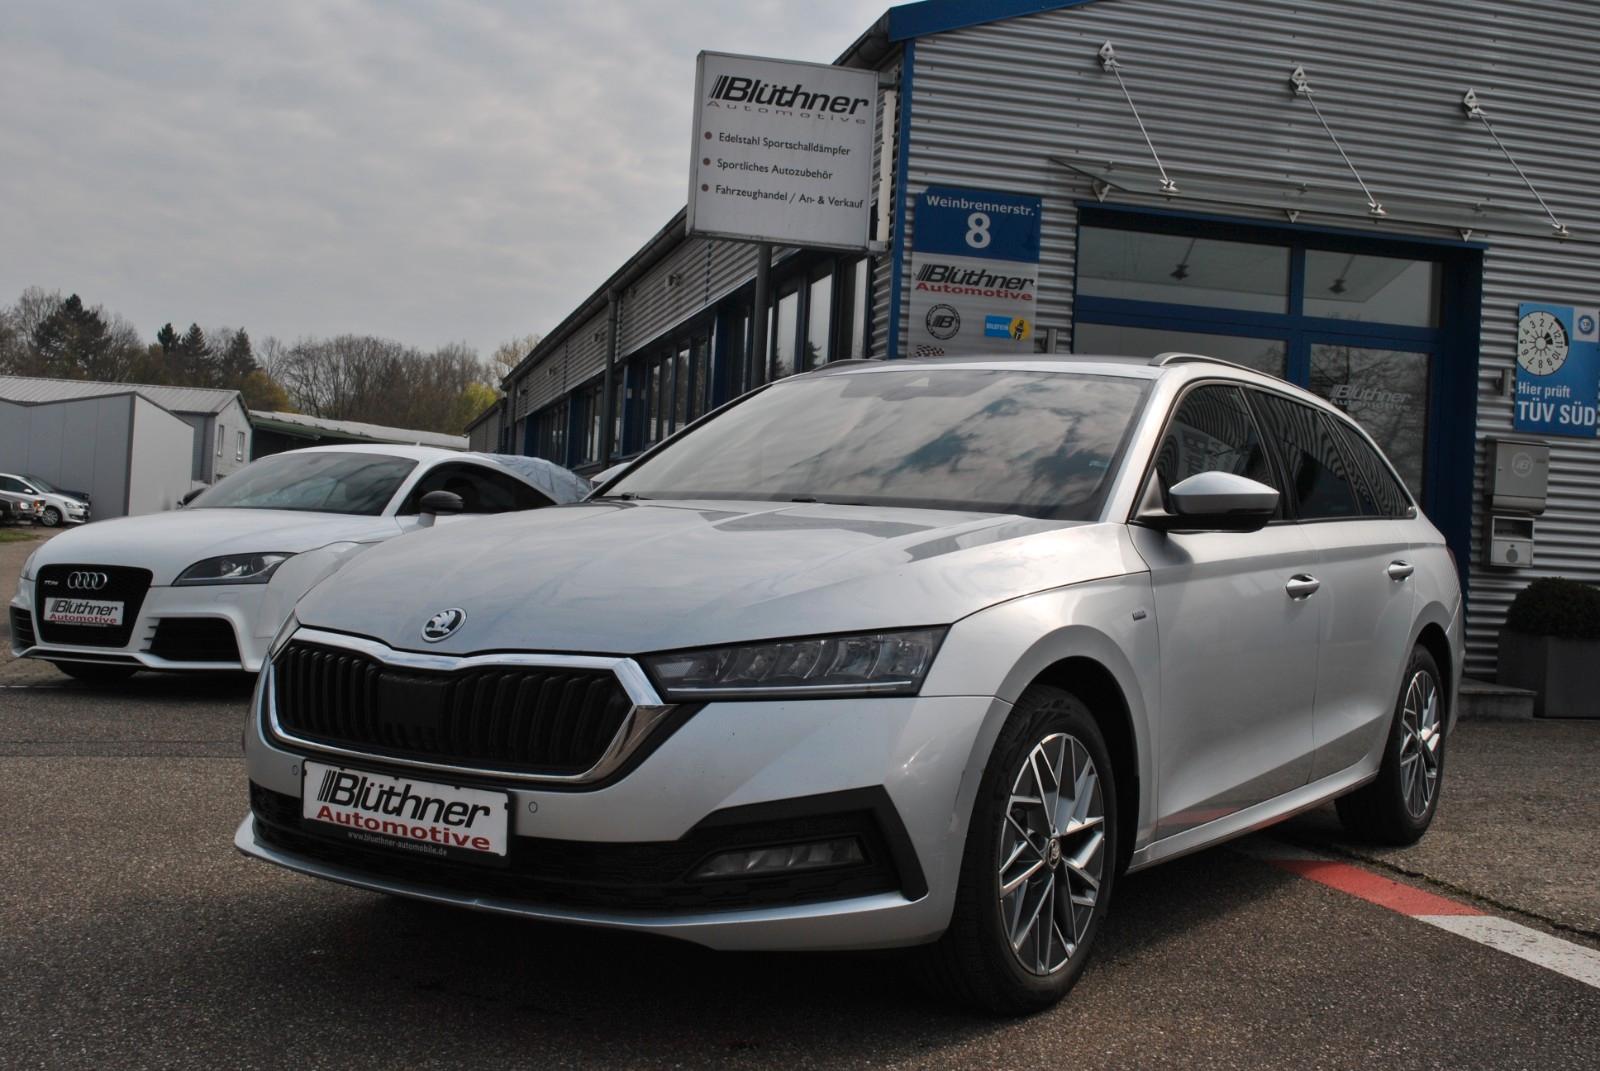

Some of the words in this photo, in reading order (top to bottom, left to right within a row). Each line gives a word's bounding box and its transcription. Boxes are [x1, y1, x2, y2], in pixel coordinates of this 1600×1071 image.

[721, 75, 869, 115] Blüthner
[706, 100, 866, 124] Automotive
[719, 132, 760, 146] Edelstahl
[763, 137, 851, 156] Sportschalldämpfer
[717, 158, 769, 173] Sportliches
[771, 165, 833, 180] Autozubehör
[715, 184, 788, 201] Fahrzeughandel
[817, 195, 825, 205] &
[828, 196, 864, 209] Verkauf
[926, 195, 1035, 216] Weinbrennerstr.
[965, 212, 991, 249] 8
[926, 263, 1034, 291] Blüthner
[915, 282, 1033, 301] Automotive
[1530, 320, 1536, 329] 3
[1540, 318, 1545, 327] 2
[1548, 322, 1554, 330] 1
[1553, 330, 1562, 340] 12
[1556, 341, 1563, 349] 11
[1528, 357, 1535, 365] 7
[1538, 360, 1543, 369] 8
[1552, 351, 1561, 360] 10
[1518, 381, 1542, 395] Hier
[1544, 385, 1571, 398] prüft
[1518, 398, 1555, 422] TÜV
[1560, 401, 1596, 426] SÜD
[56, 600, 118, 617] Blüthner
[49, 613, 117, 625] Automotive
[327, 771, 491, 829] Blüthner
[317, 805, 490, 851] Automotive
